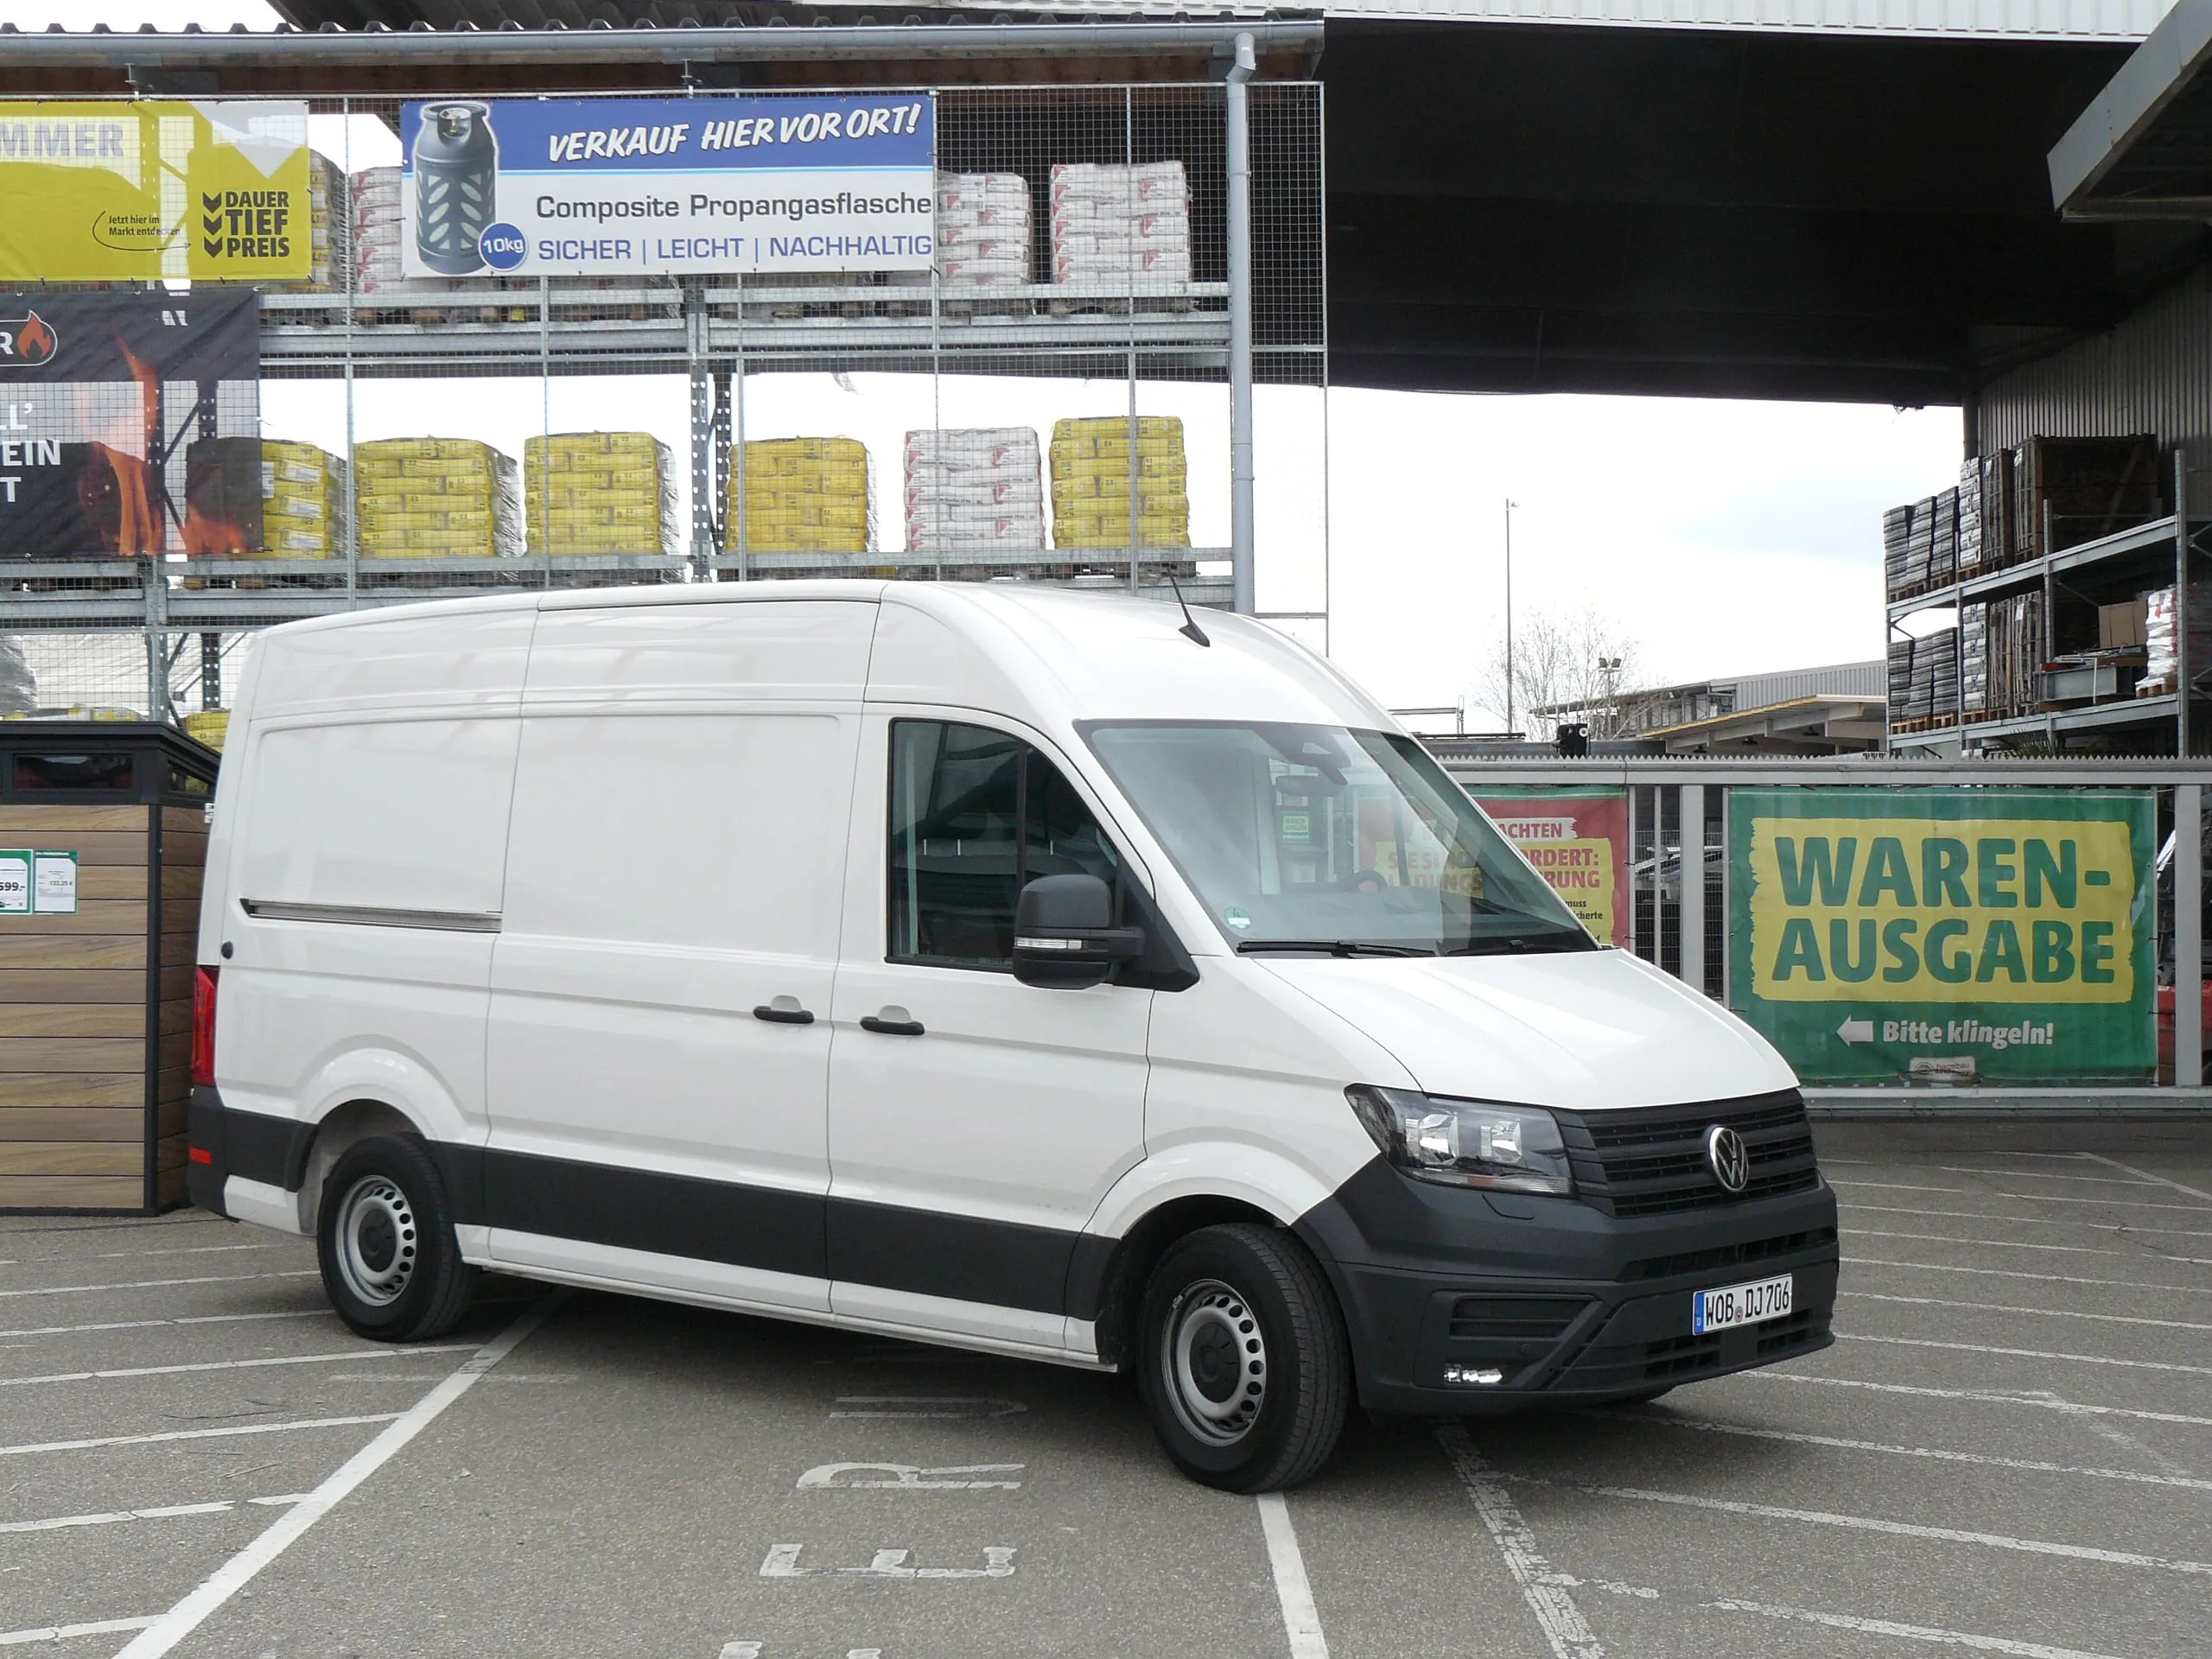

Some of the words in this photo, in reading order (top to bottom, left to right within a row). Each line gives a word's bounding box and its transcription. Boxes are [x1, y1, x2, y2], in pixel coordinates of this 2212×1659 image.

[549, 124, 690, 162] VERKAUF
[701, 118, 775, 151] HIER
[780, 112, 842, 144] VOR
[846, 103, 922, 139] ORT!
[226, 191, 289, 208] DAUER
[537, 194, 679, 225] Composite
[690, 192, 932, 221] Propangasflasche
[108, 215, 129, 225] Jetzt
[130, 214, 147, 224] hier
[149, 215, 160, 224] im
[109, 226, 135, 236] Markt
[225, 209, 289, 236] TIEF
[227, 237, 290, 257] PREIS
[483, 237, 524, 255] 10kg
[538, 239, 631, 260] SICHER
[658, 238, 745, 259] LEICHT
[771, 235, 932, 257] NACHHALTIG
[1540, 870, 1600, 888] RUNG
[1774, 836, 2111, 909] WAREN-
[1771, 918, 2115, 983] AUSGABE
[1883, 1020, 1943, 1045] Bitte
[1947, 1020, 2054, 1051] klingeln!
[1706, 1293, 1734, 1326] WOB
